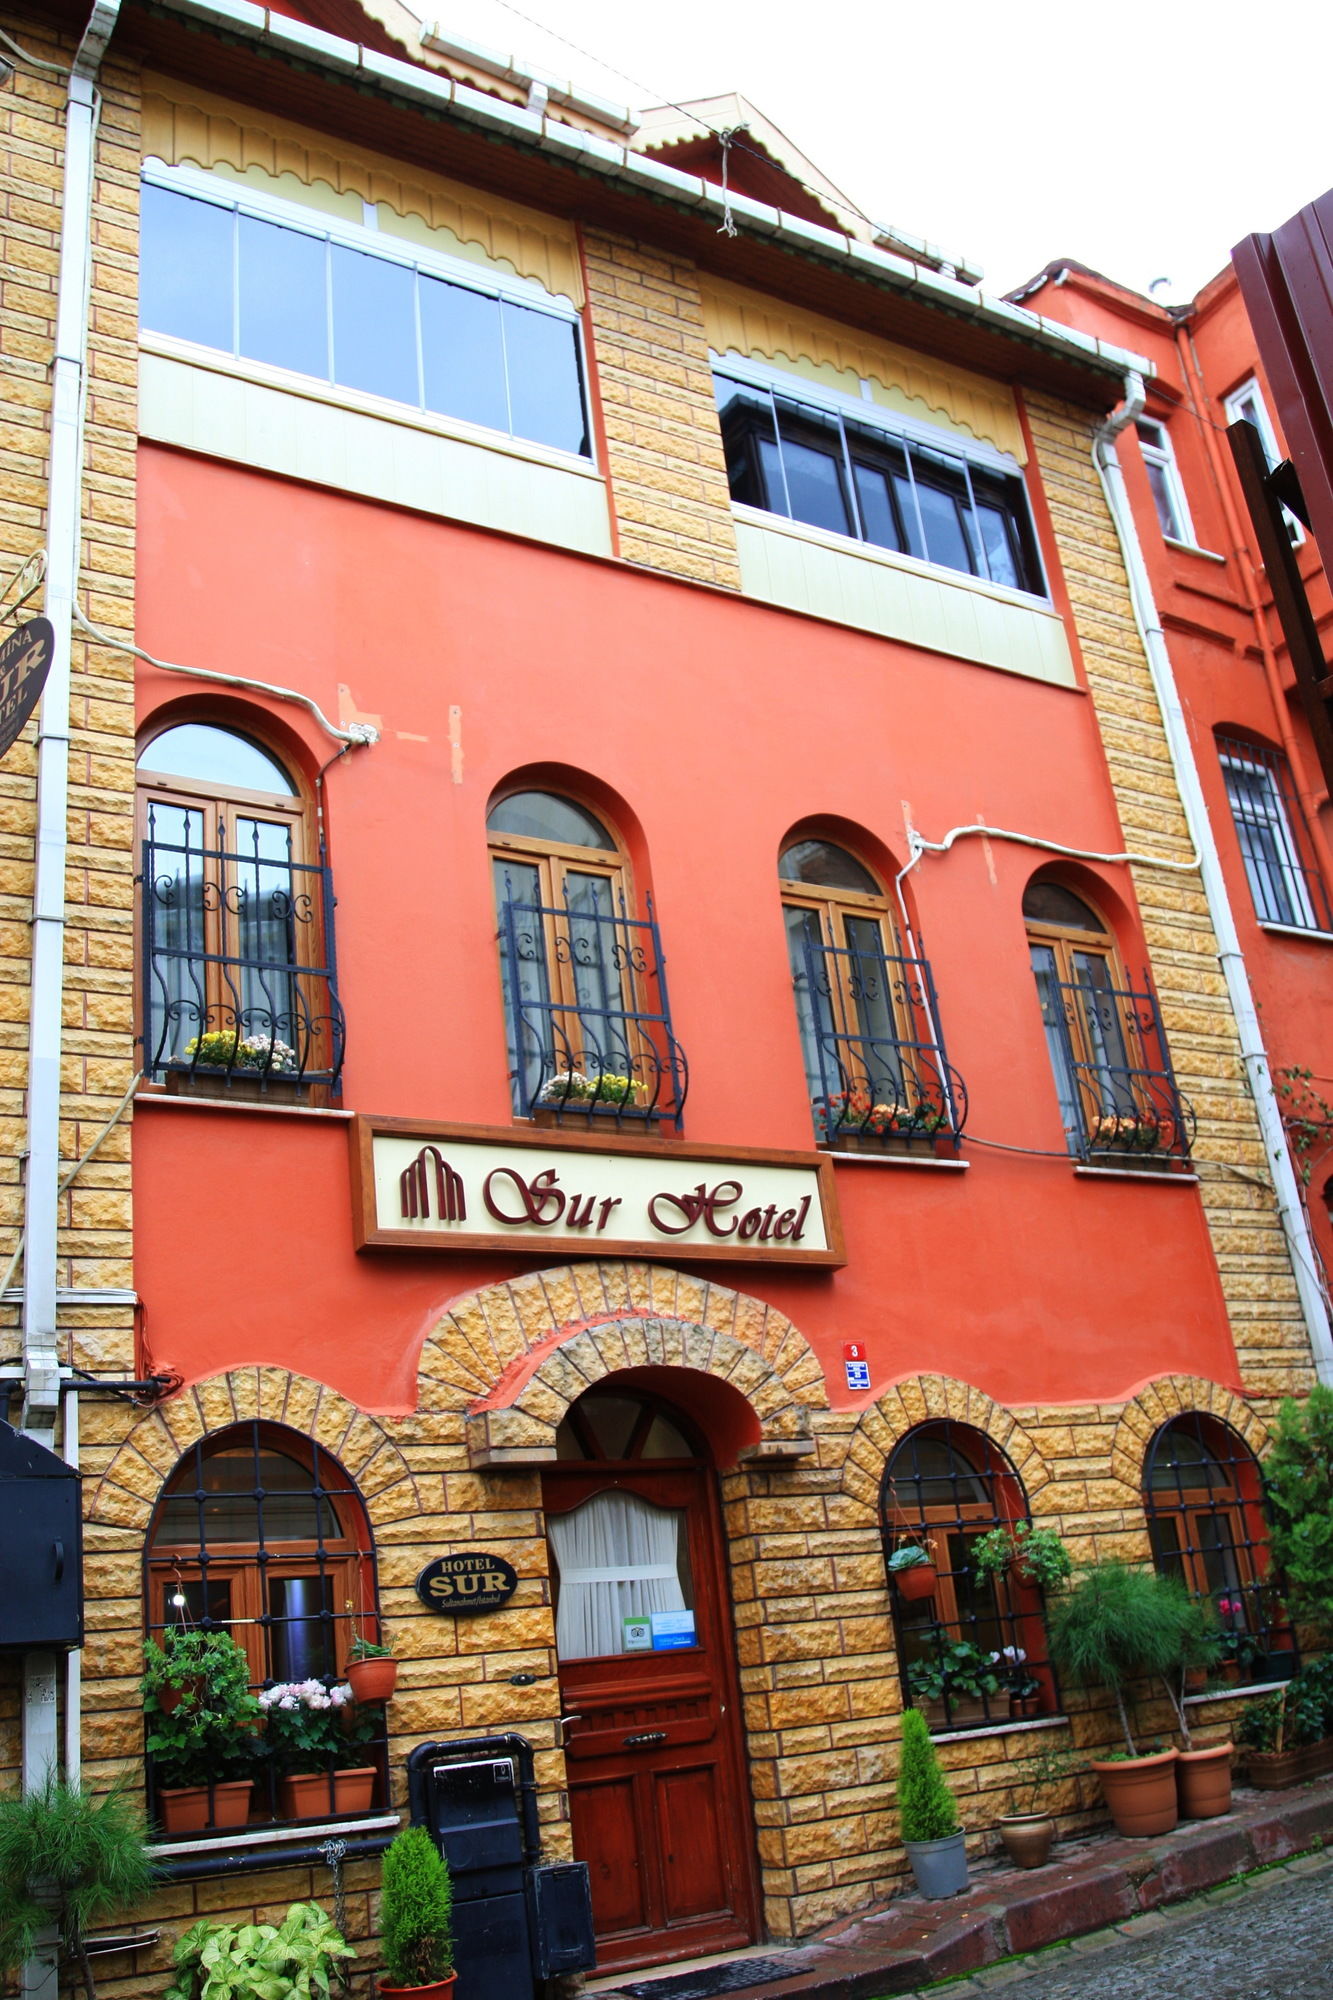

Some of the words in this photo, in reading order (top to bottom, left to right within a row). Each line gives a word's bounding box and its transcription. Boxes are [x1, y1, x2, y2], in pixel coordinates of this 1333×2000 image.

[483, 1167, 622, 1231] Sur
[648, 1180, 813, 1241] Hotel
[850, 1345, 859, 1357] 3
[441, 1558, 495, 1573] HOTEL
[429, 1571, 510, 1597] SUR
